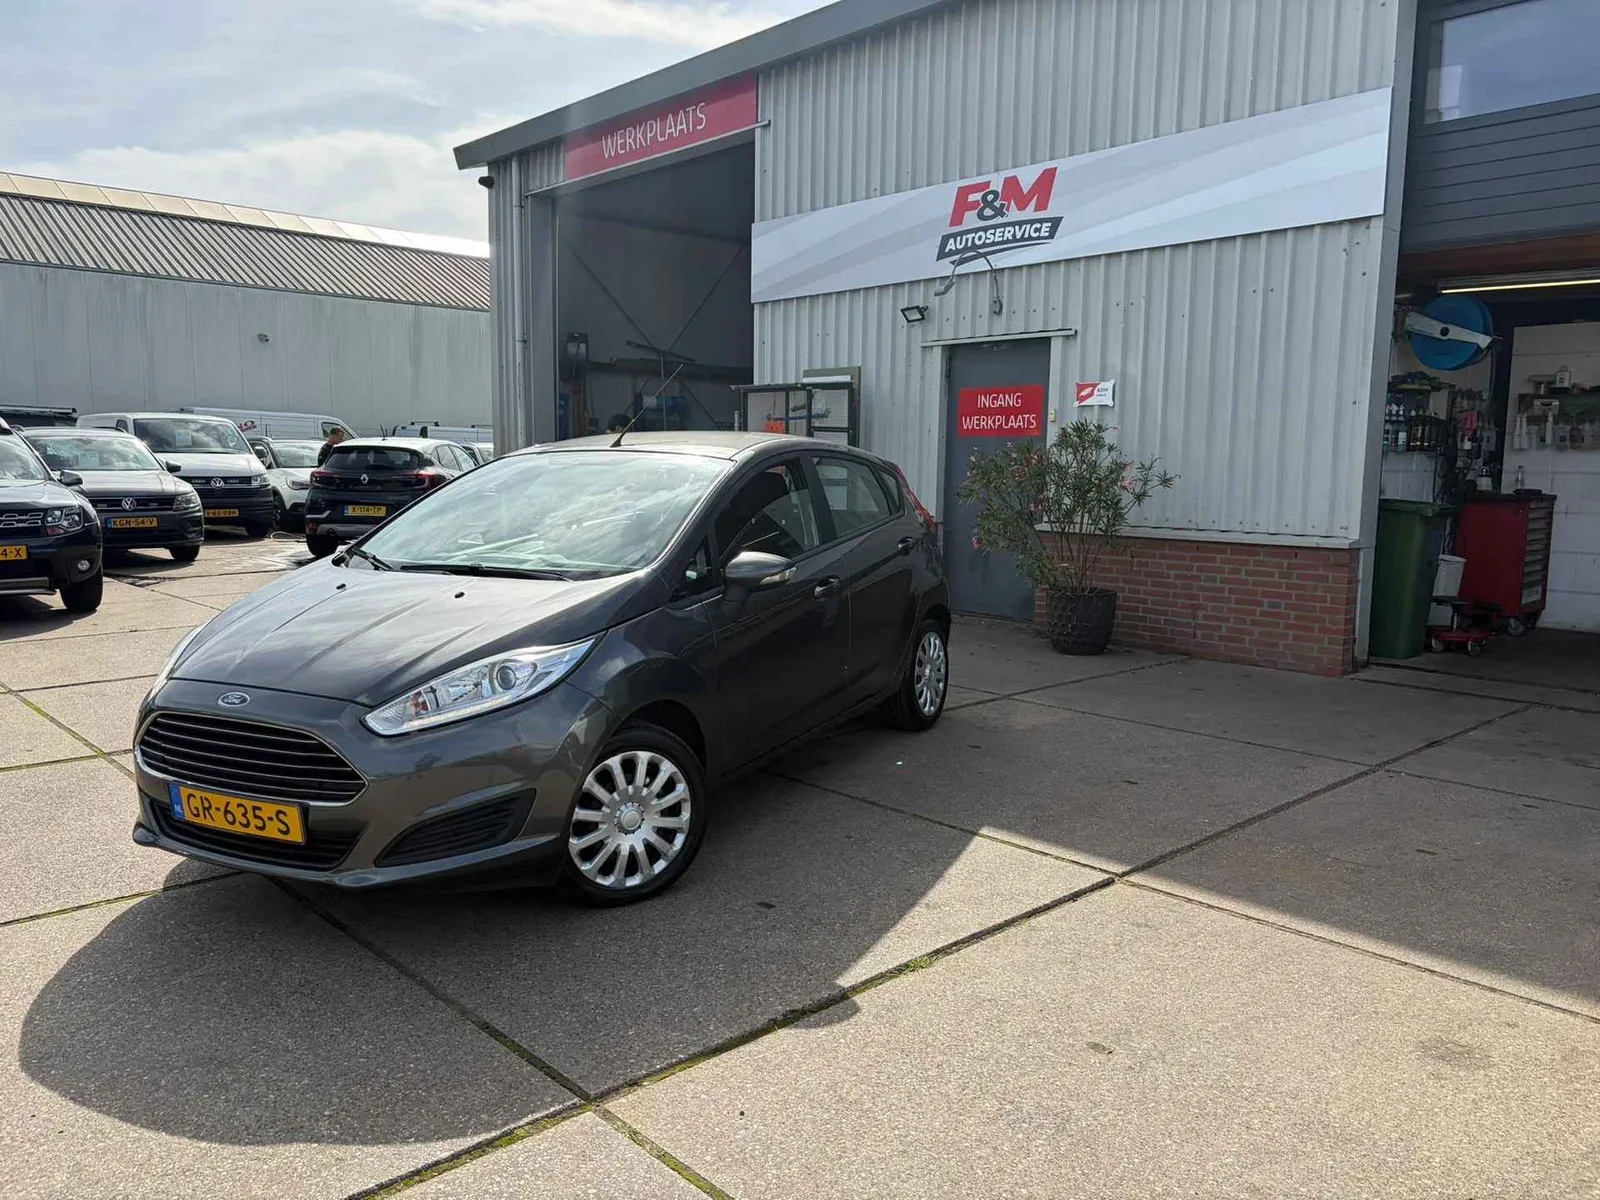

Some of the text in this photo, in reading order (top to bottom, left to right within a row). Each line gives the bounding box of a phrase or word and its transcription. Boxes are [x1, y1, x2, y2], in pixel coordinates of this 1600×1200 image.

[602, 102, 707, 159] WERKPLAATS
[949, 166, 1058, 228] F&M
[945, 222, 1052, 253] AUTOSERVICE
[977, 392, 1022, 408] INGANG
[962, 414, 1037, 430] WERKPLAATS
[112, 518, 154, 528] KGN-54-V
[186, 792, 291, 836] GR-635-S
